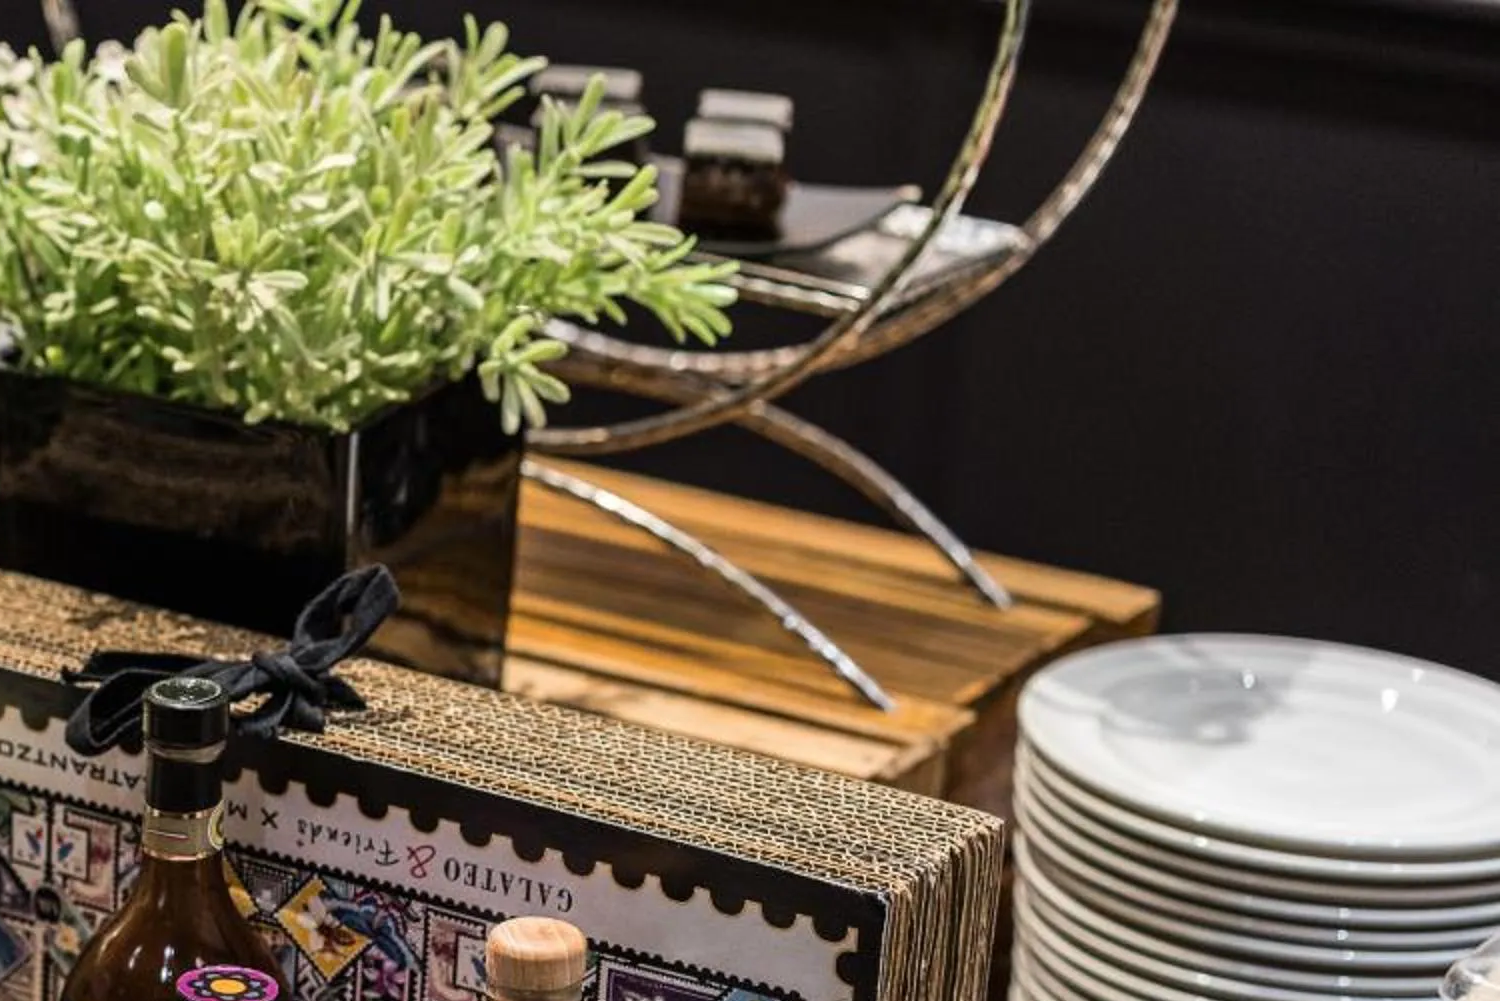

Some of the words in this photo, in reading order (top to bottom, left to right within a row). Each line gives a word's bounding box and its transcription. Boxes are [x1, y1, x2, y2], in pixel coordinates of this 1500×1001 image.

[296, 818, 399, 866] Friends
[406, 844, 436, 879] &
[443, 857, 573, 913] GALATEO
